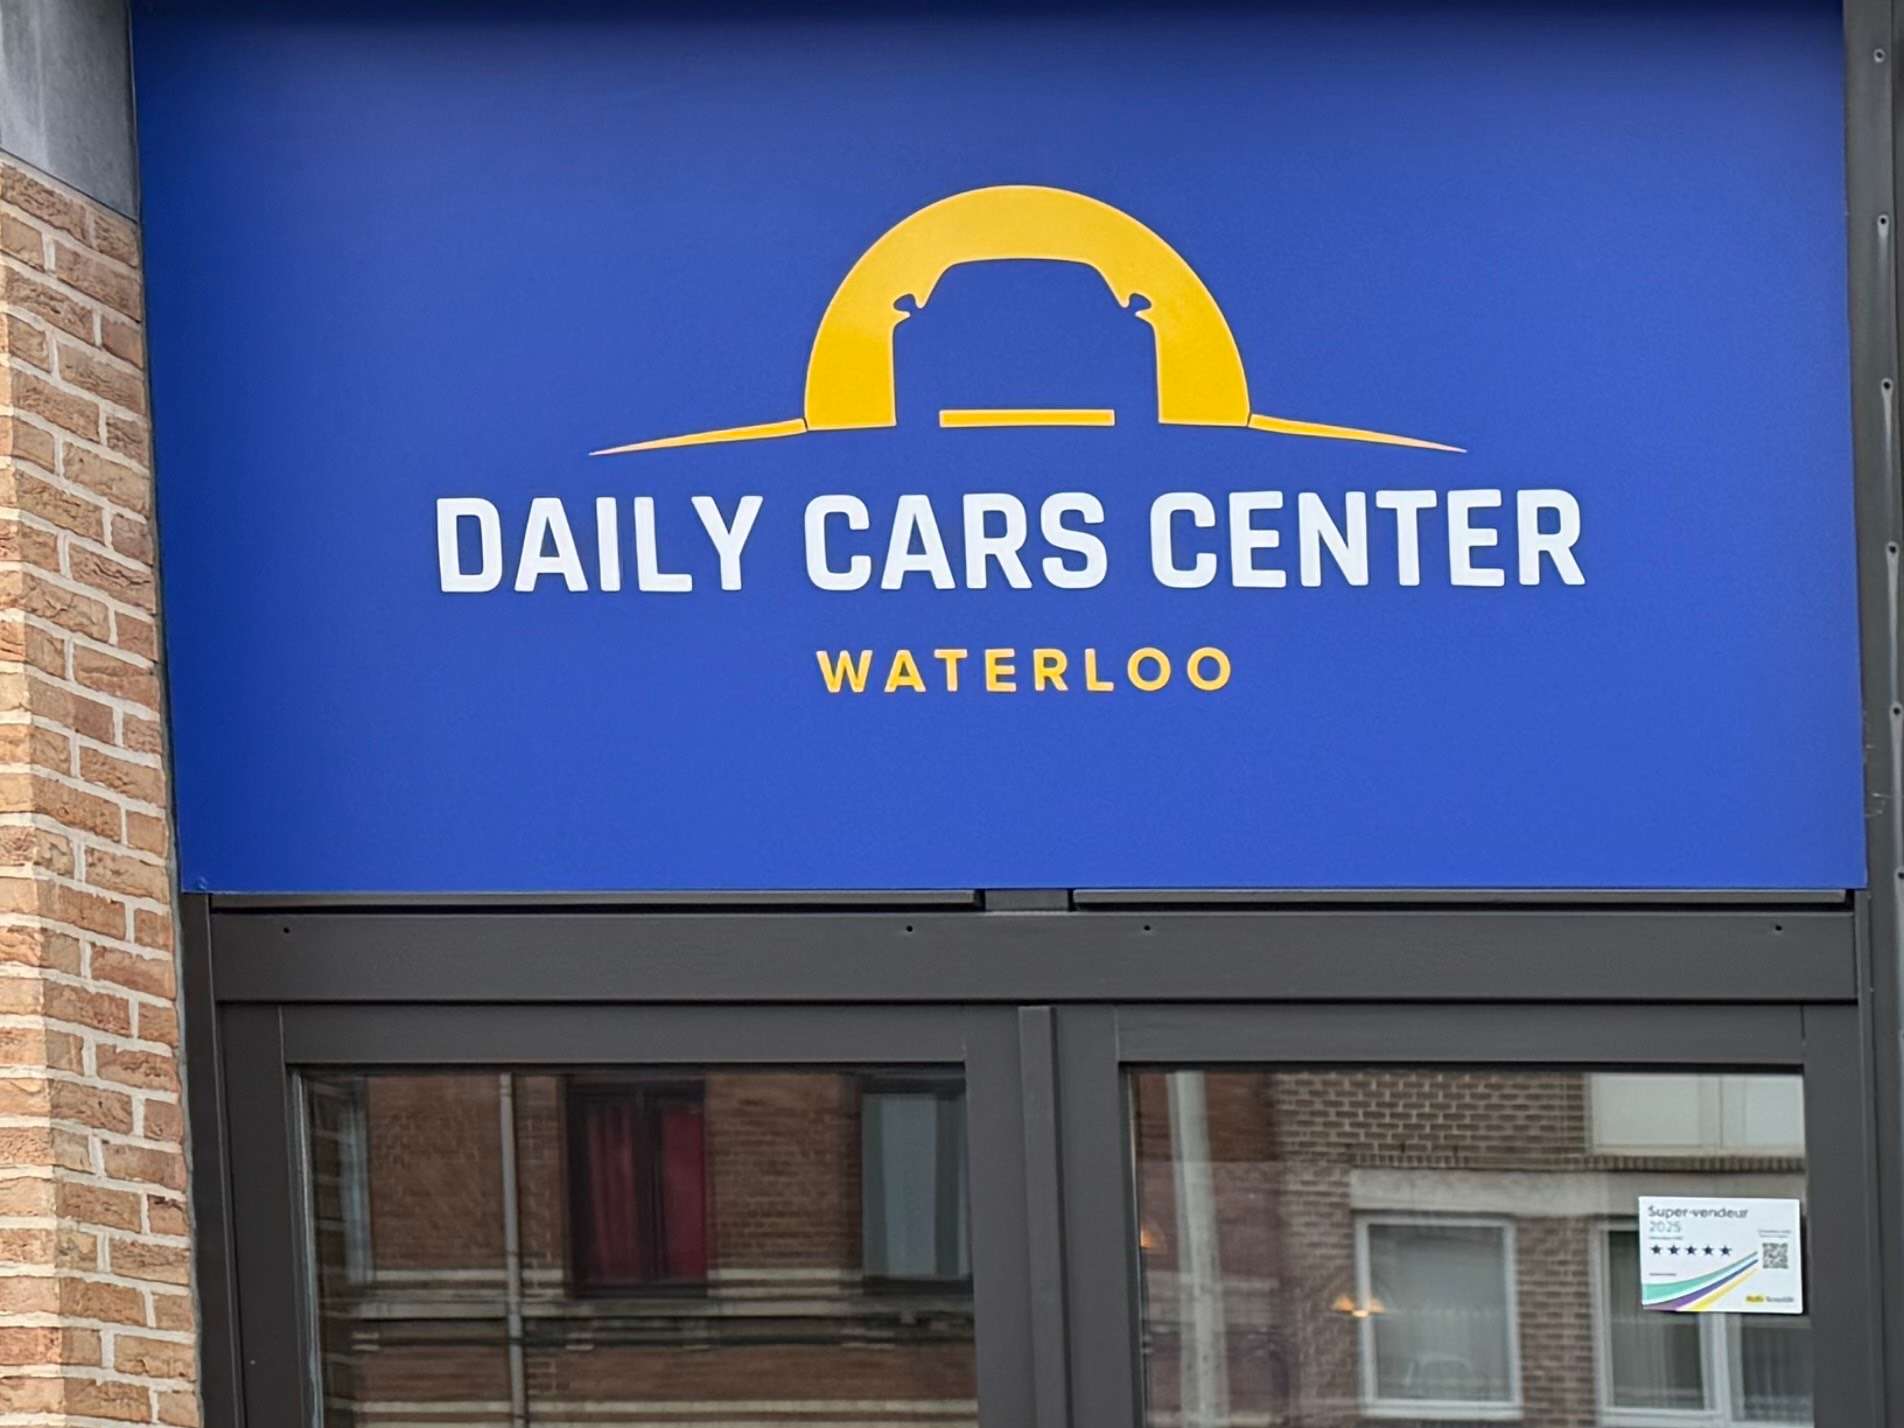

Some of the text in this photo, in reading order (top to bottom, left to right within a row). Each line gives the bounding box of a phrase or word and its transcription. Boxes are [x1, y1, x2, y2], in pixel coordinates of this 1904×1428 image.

[436, 488, 1585, 594] DAILY CARS CENTER
[816, 646, 1233, 694] WATERLOO
[1648, 1205, 1748, 1219] Super-vendeur
